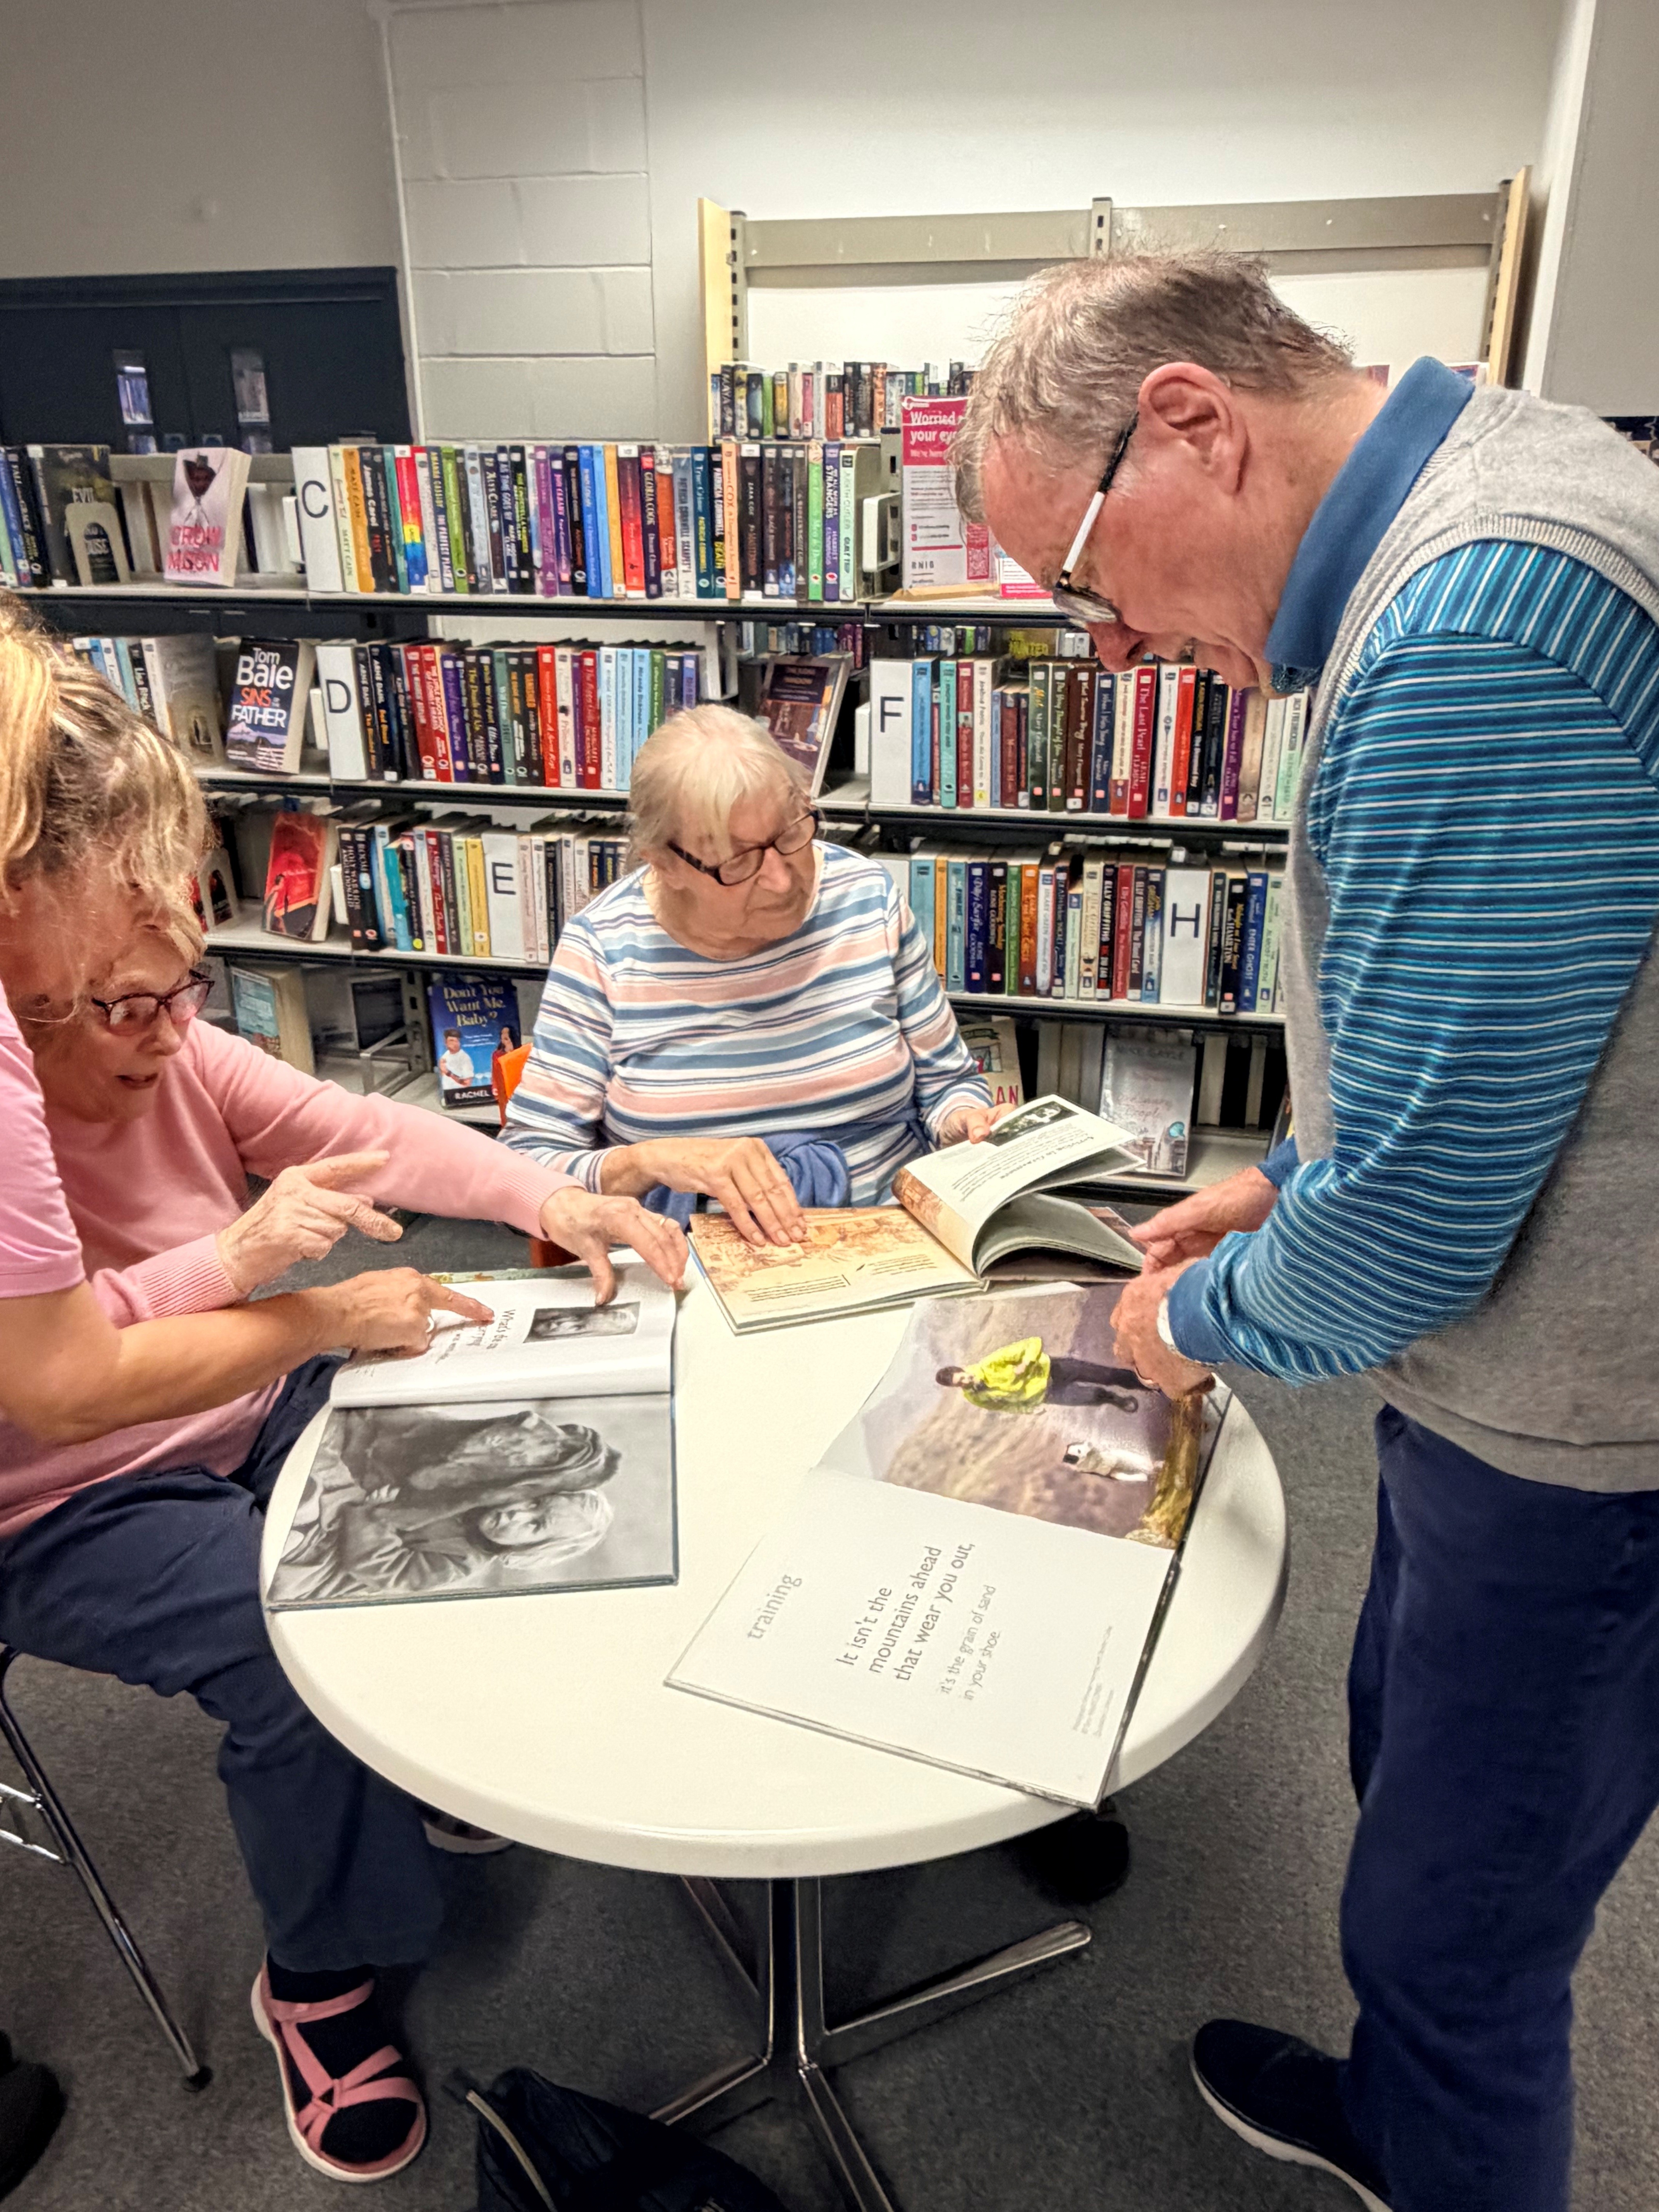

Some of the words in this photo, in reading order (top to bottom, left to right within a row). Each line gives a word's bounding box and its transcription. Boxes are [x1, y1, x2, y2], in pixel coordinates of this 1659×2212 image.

[910, 411, 956, 426] Worried
[910, 431, 938, 446] your
[301, 480, 329, 519] C
[726, 485, 735, 507] COX
[825, 465, 834, 519] STRANGERS
[252, 647, 280, 665] Tom
[236, 655, 293, 690] Bale
[240, 687, 272, 708] SINS
[326, 679, 351, 713] D
[1139, 686, 1151, 704] The
[232, 704, 287, 728] FATHER
[880, 696, 904, 732] F
[1136, 728, 1147, 750] Pearl
[347, 845, 356, 868] HOLY
[351, 871, 361, 910] WARRIOR
[491, 862, 516, 895] E
[1170, 902, 1200, 938] H
[447, 1000, 481, 1012] Want
[455, 1090, 489, 1100] RACHEL
[747, 1574, 802, 1639] training
[867, 1587, 892, 1612] the
[869, 1592, 919, 1673] mountains
[909, 1546, 942, 1589] ahead
[978, 1585, 996, 1611] sand
[893, 1648, 922, 1681] that
[914, 1604, 941, 1644] wear
[933, 1573, 958, 1603] you
[970, 1609, 985, 1625] of
[846, 1616, 879, 1649] isn't
[959, 1626, 979, 1655] grain
[835, 1652, 859, 1666] It
[947, 1656, 965, 1674] the
[962, 1689, 975, 1700] in
[969, 1660, 987, 1688] your
[979, 1631, 1001, 1658] shoe
[939, 1677, 956, 1694] it's
